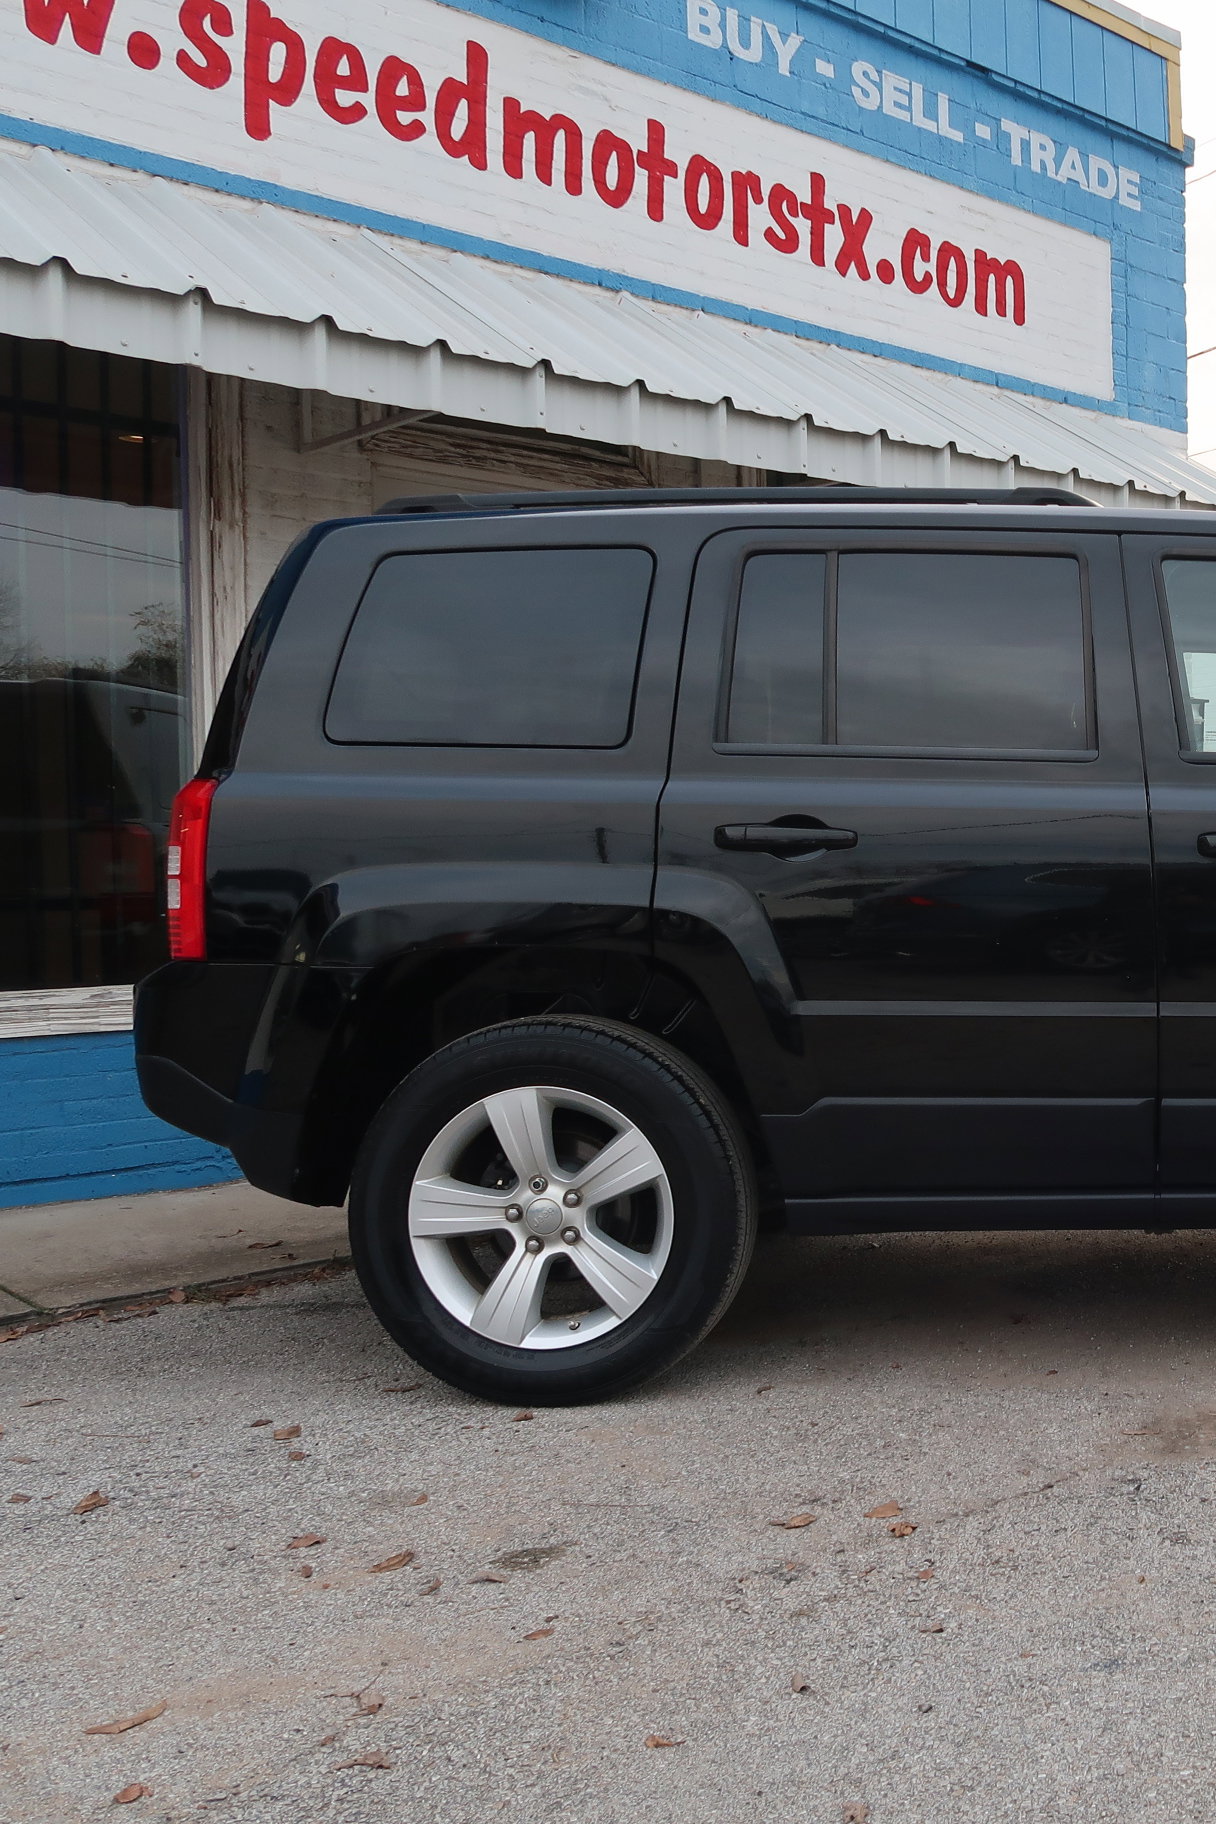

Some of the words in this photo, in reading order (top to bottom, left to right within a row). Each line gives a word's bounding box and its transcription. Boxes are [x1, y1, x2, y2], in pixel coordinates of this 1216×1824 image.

[686, 0, 805, 77] BUY
[851, 60, 964, 143] SELL
[1000, 118, 1141, 212] TRADE
